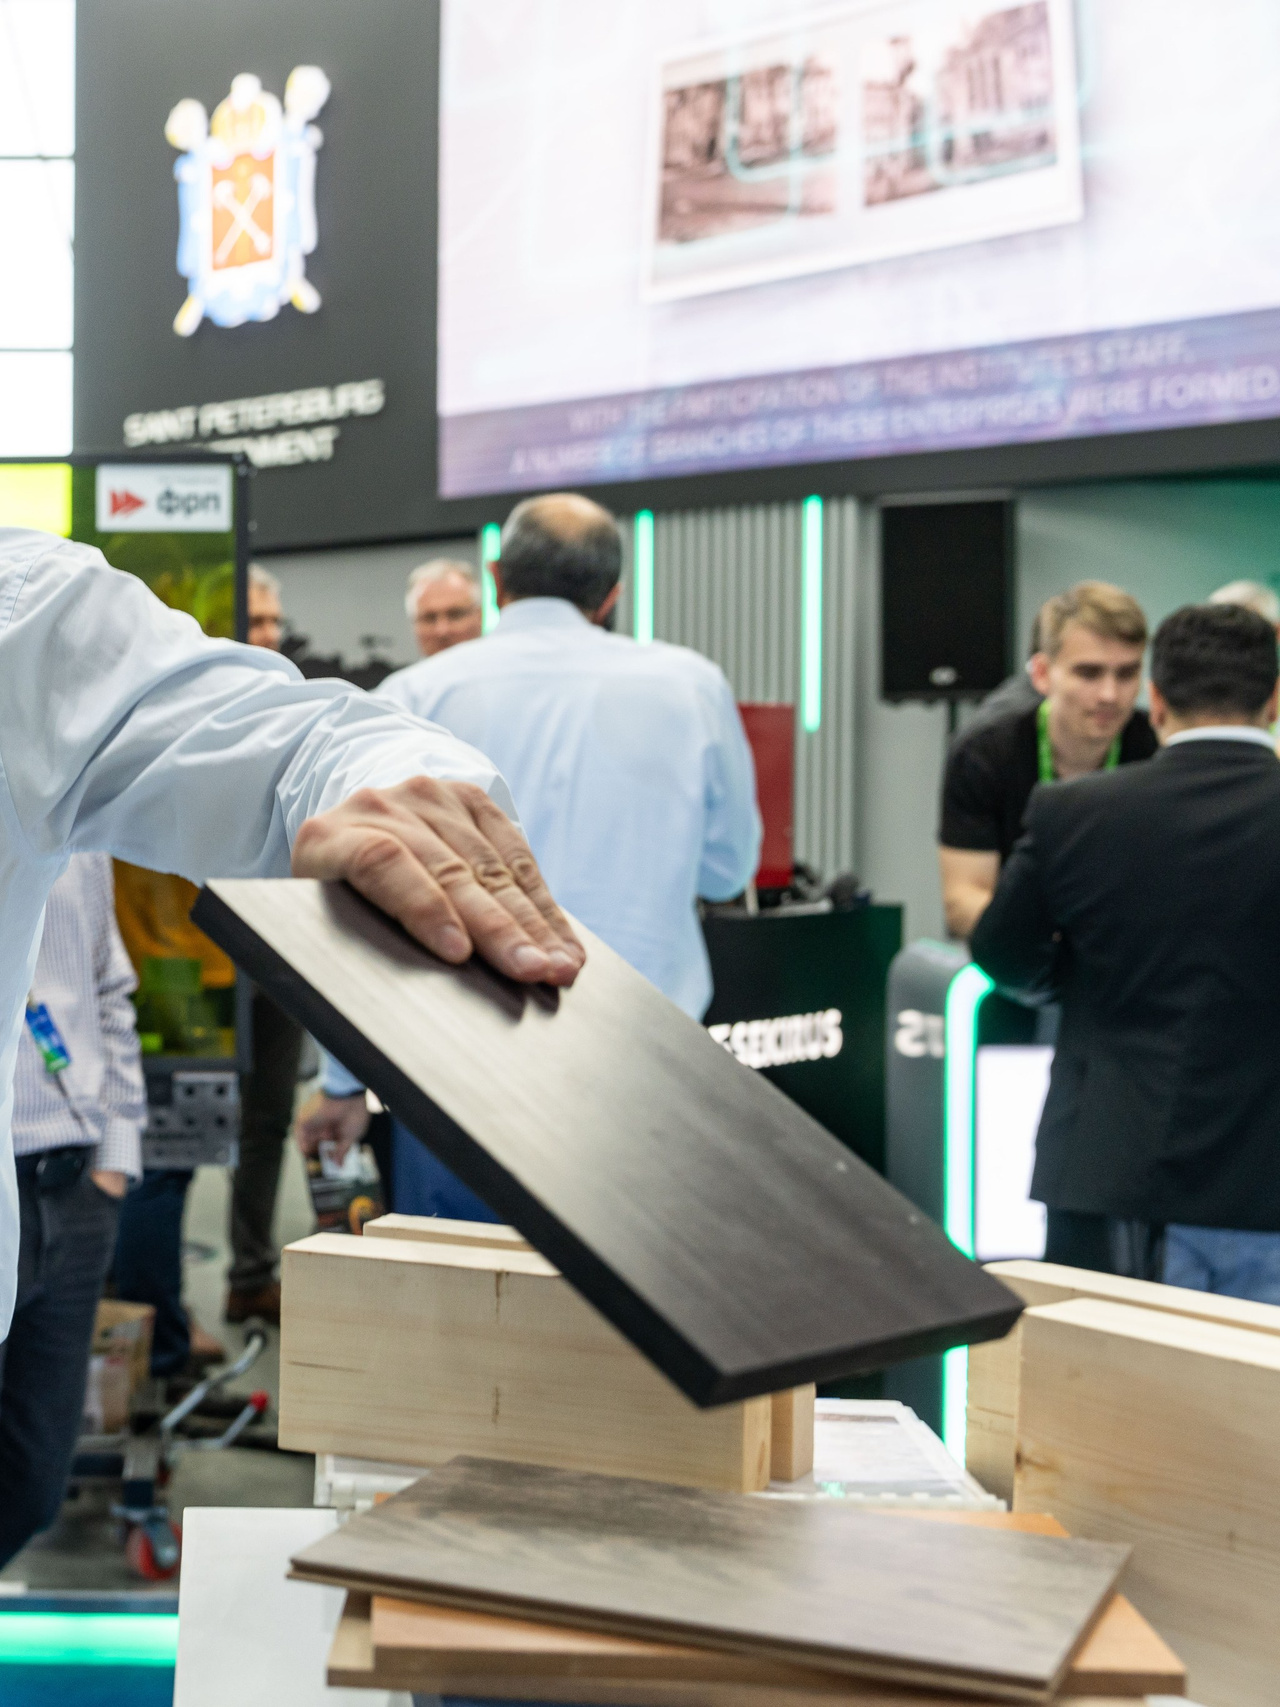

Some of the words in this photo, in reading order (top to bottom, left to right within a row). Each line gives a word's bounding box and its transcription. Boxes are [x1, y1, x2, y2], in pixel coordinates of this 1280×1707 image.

[842, 371, 877, 401] OF
[884, 364, 931, 394] THE
[123, 406, 197, 447] SAINT
[198, 378, 385, 437] PETERSBURG
[649, 422, 769, 463] BRANCHES
[772, 420, 808, 449] OF
